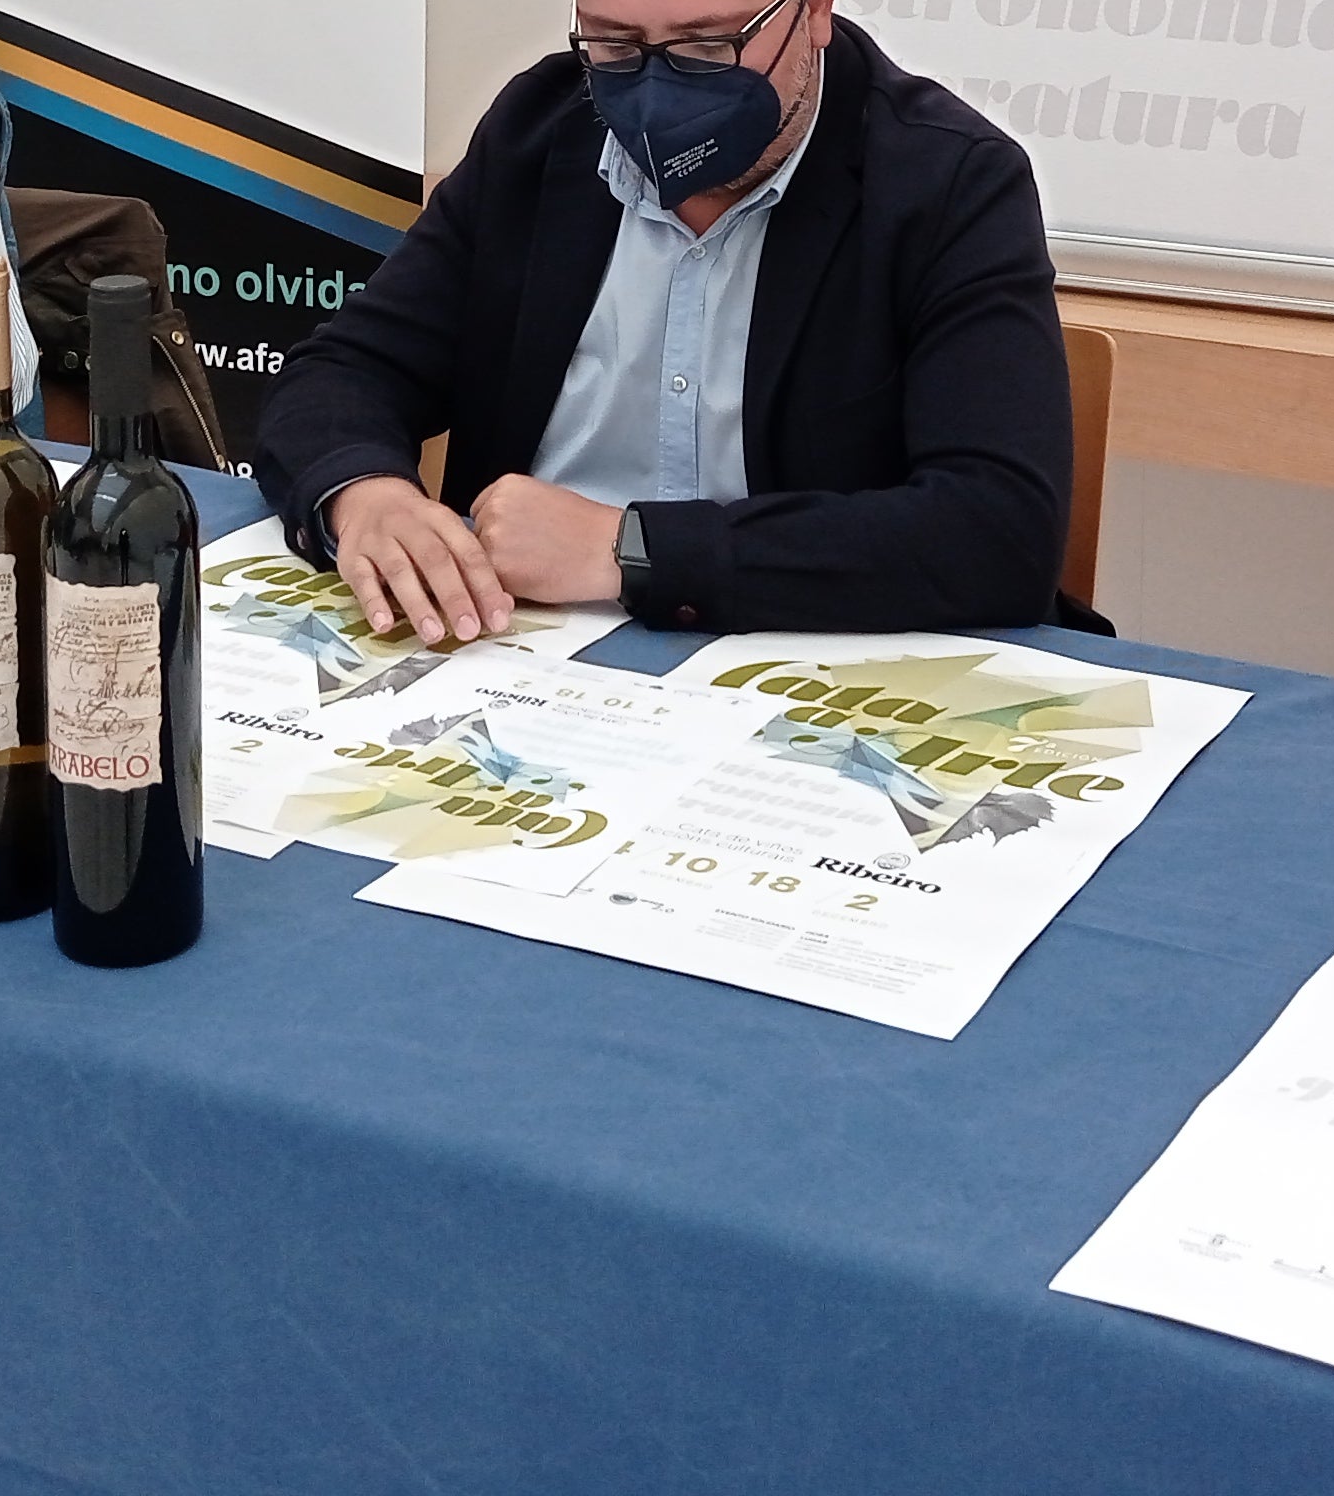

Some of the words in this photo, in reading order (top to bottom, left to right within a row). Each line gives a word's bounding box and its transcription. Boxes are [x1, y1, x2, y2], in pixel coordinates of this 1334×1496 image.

[166, 262, 221, 297] no
[710, 660, 948, 725] Cata
[217, 710, 325, 744] Ribeiro
[827, 732, 1125, 803] Arte
[433, 794, 608, 850] Cata
[664, 851, 718, 874] 10
[749, 870, 802, 893] 18
[845, 894, 878, 912] 2
[811, 856, 942, 895] Ribeiro
